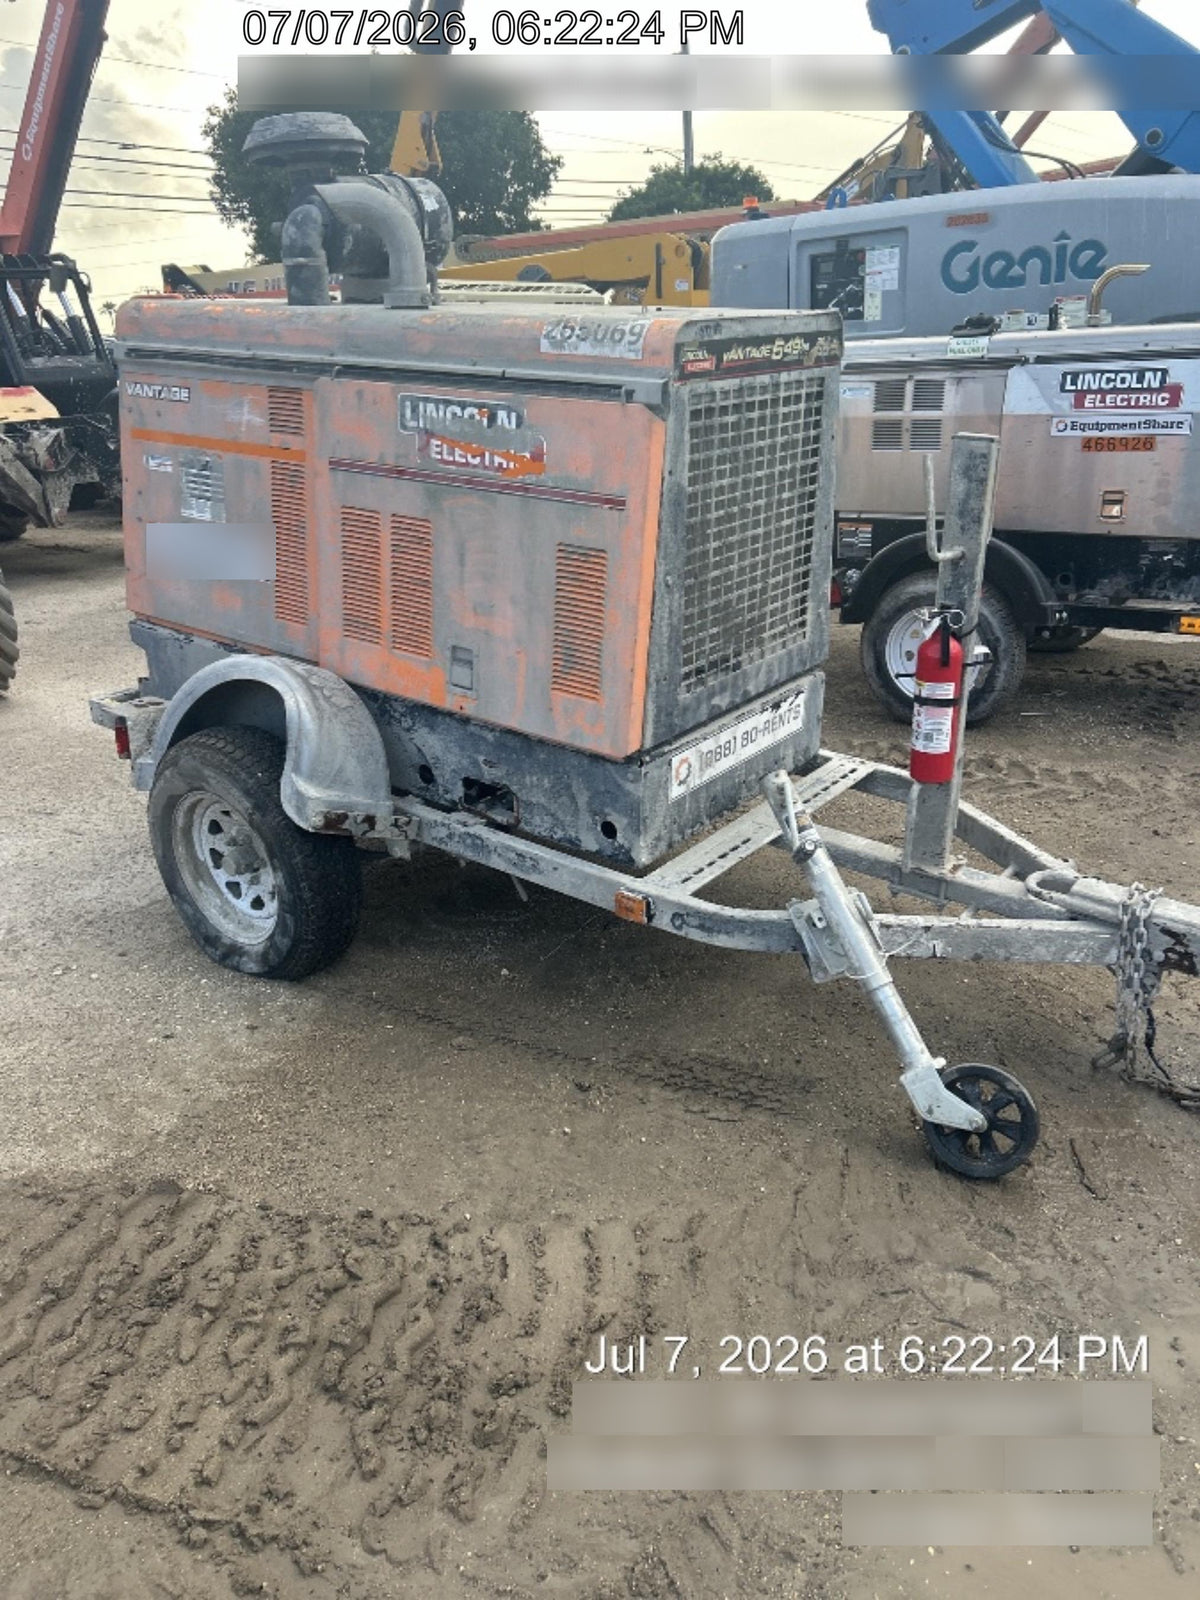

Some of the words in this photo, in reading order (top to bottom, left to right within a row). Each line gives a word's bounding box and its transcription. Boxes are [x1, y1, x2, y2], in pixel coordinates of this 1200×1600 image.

[940, 229, 1109, 295] Genie
[1064, 371, 1163, 391] LINCOLN
[125, 383, 190, 401] VANTAGE
[1083, 392, 1171, 408] ELECTRIC
[1069, 419, 1185, 432] EquipmentShare
[1081, 437, 1154, 451] 466926
[741, 703, 802, 748] 80-RENTS
